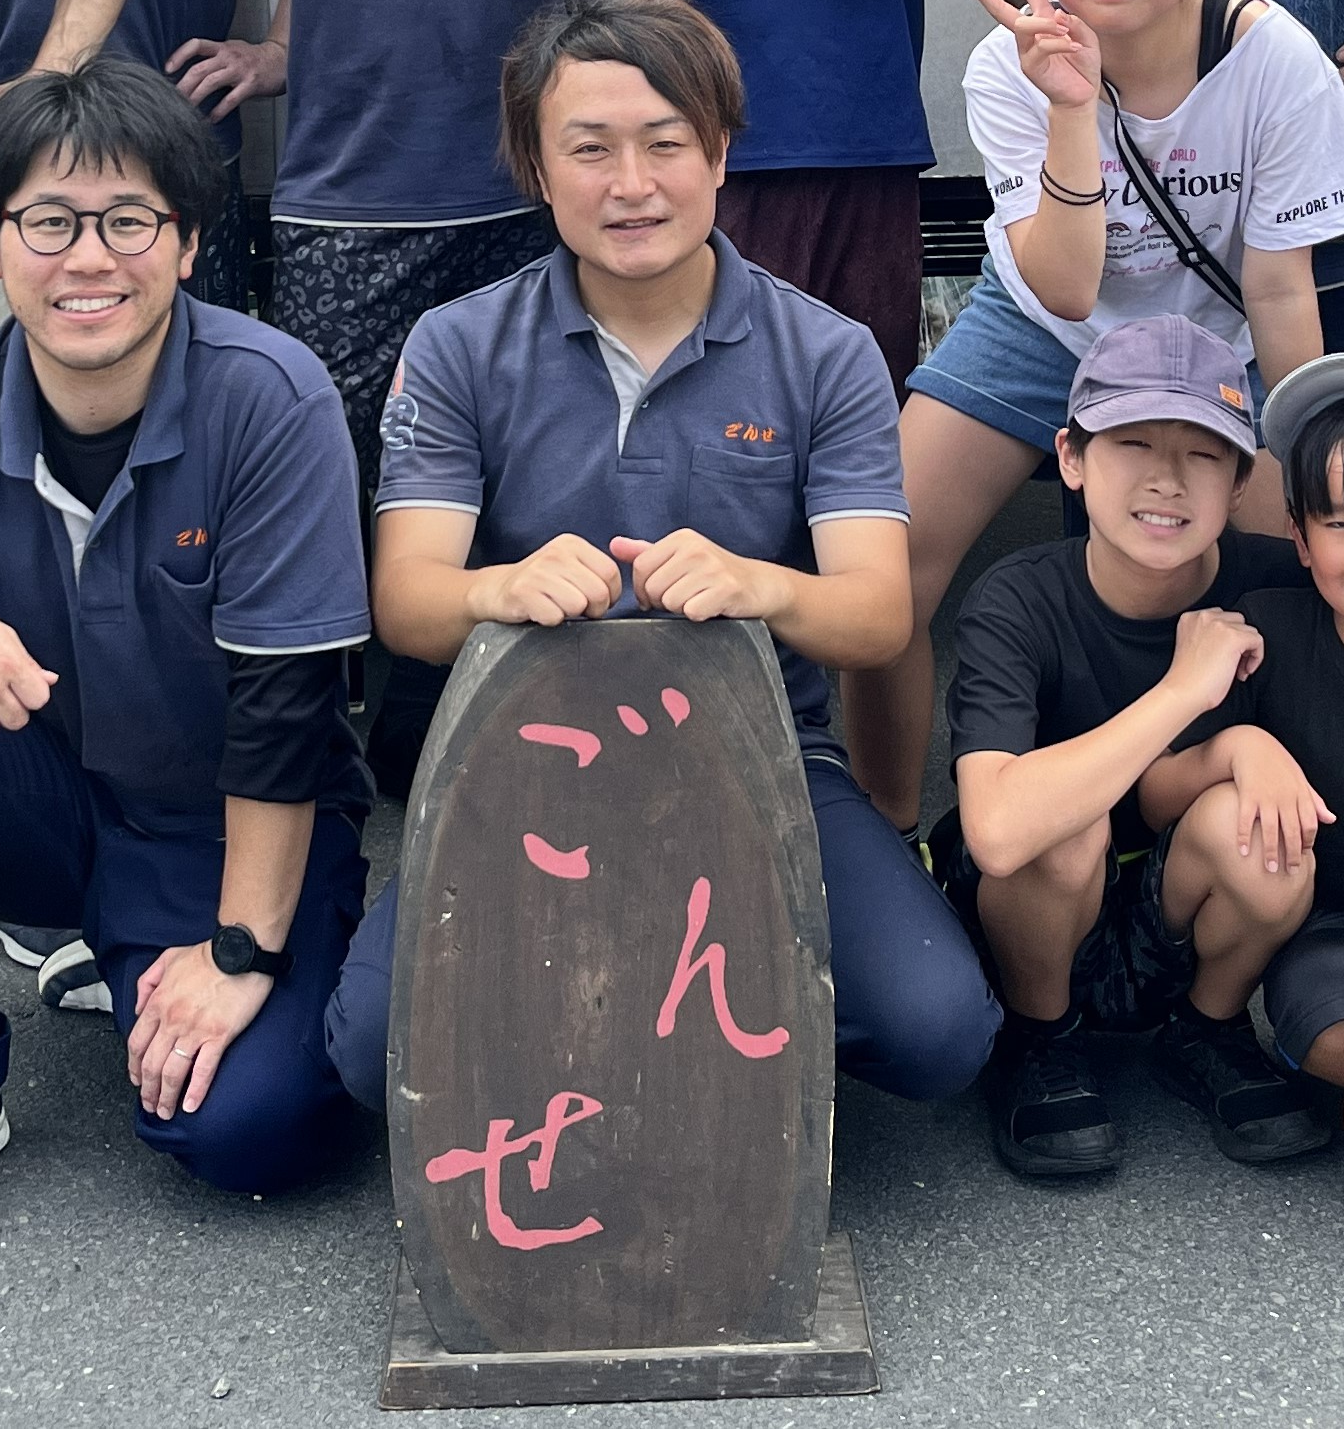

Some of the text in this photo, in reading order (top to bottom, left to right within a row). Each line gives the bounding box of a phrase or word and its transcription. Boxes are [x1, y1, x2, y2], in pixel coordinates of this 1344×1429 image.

[1276, 196, 1329, 224] EXPLORE
[424, 687, 790, 1250] ごんせ
